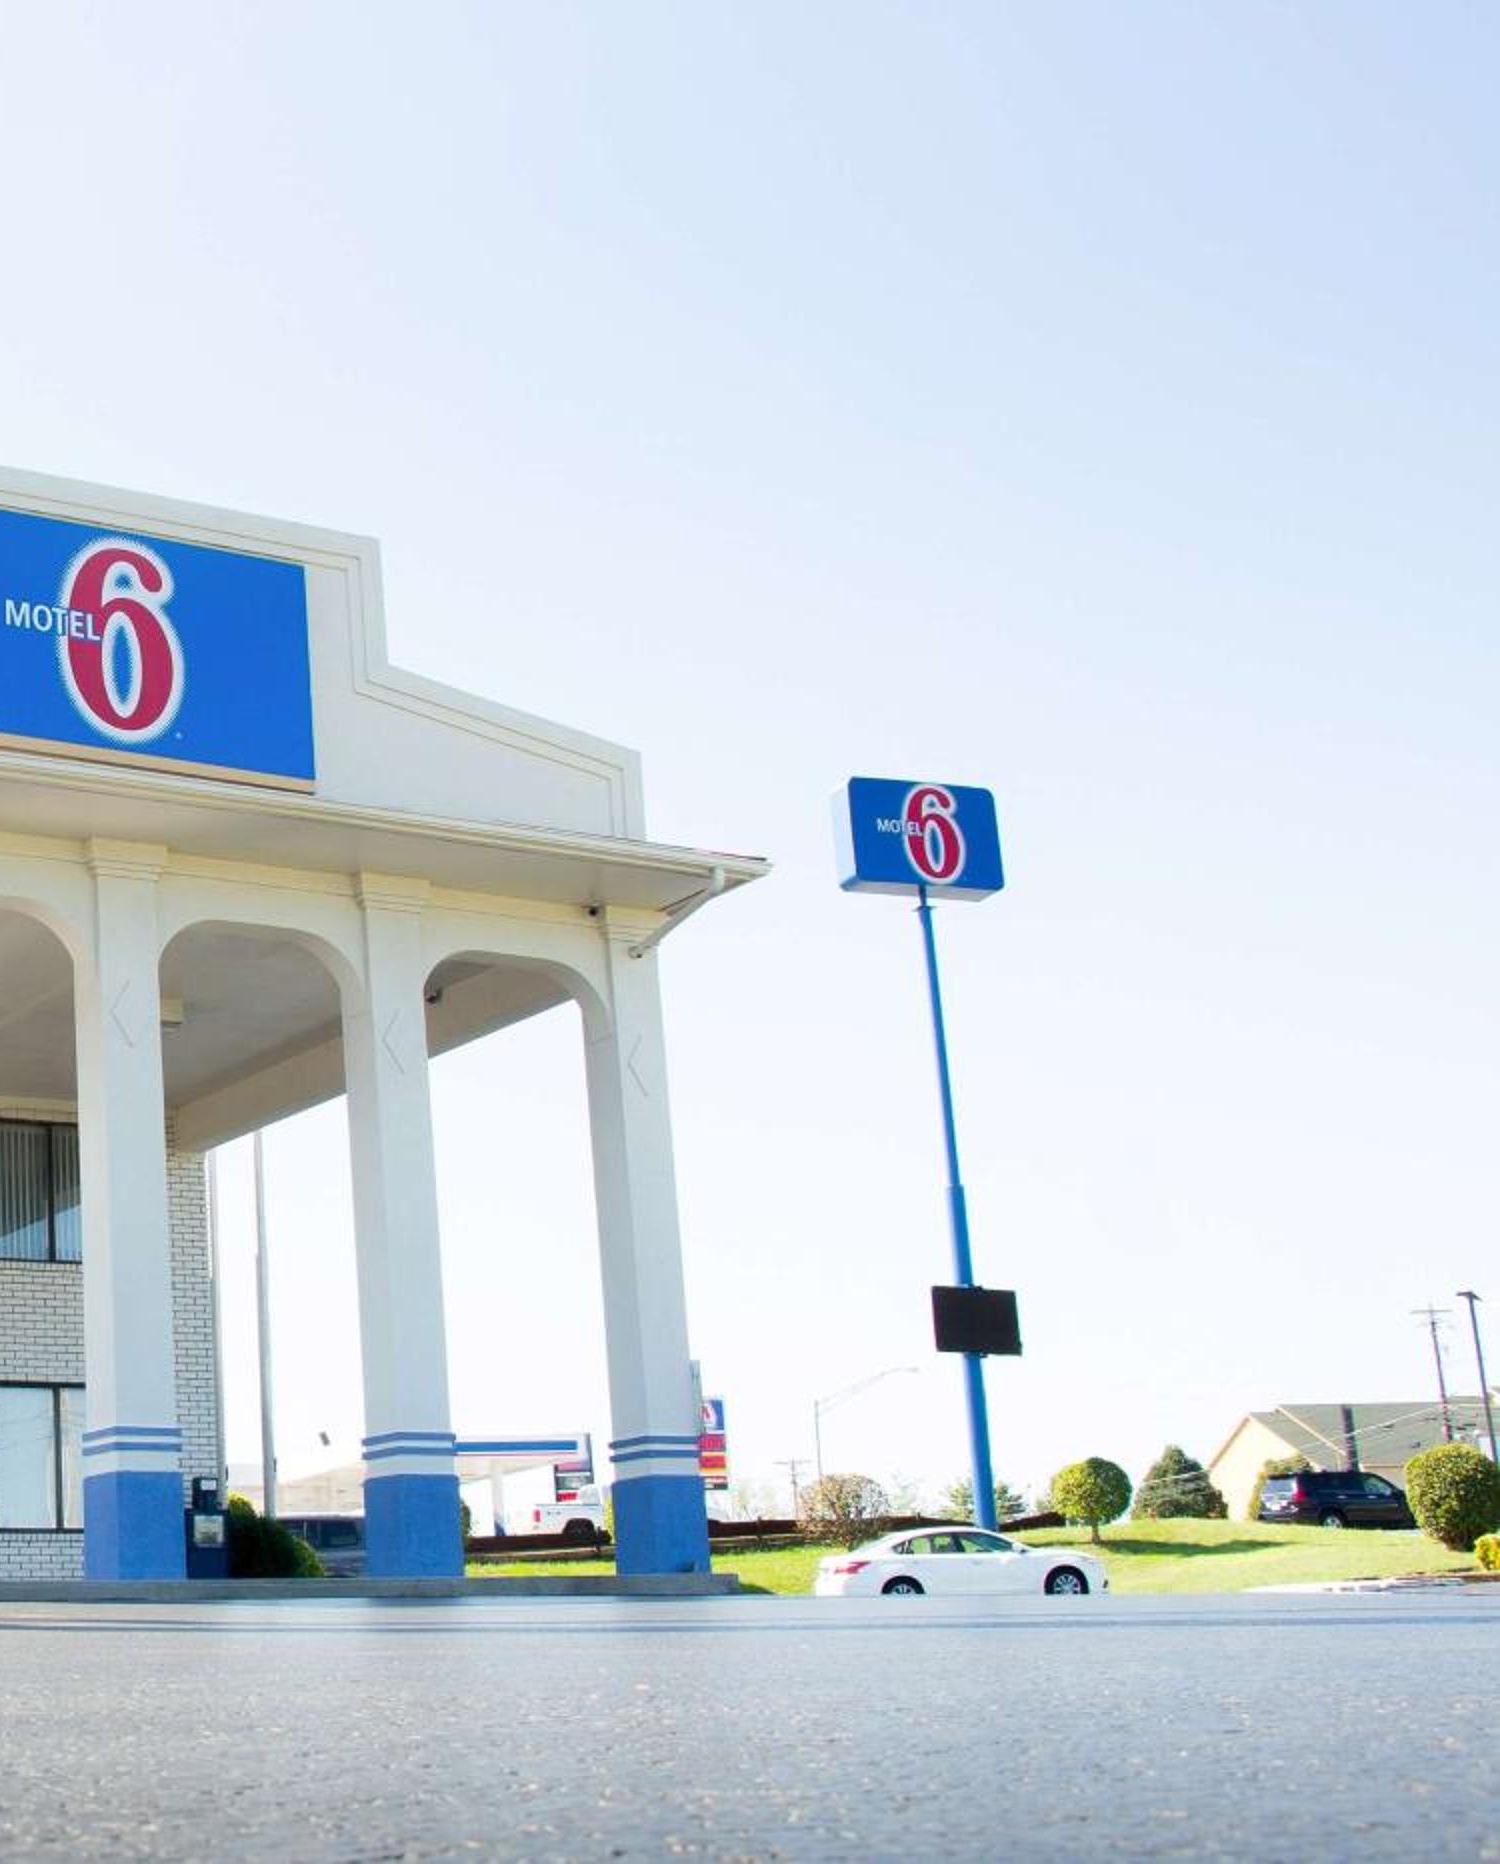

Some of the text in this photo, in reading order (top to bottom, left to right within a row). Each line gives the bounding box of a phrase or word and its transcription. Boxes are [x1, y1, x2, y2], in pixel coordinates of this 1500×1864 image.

[5, 542, 179, 737] MOTEL 6
[904, 786, 963, 882] 6
